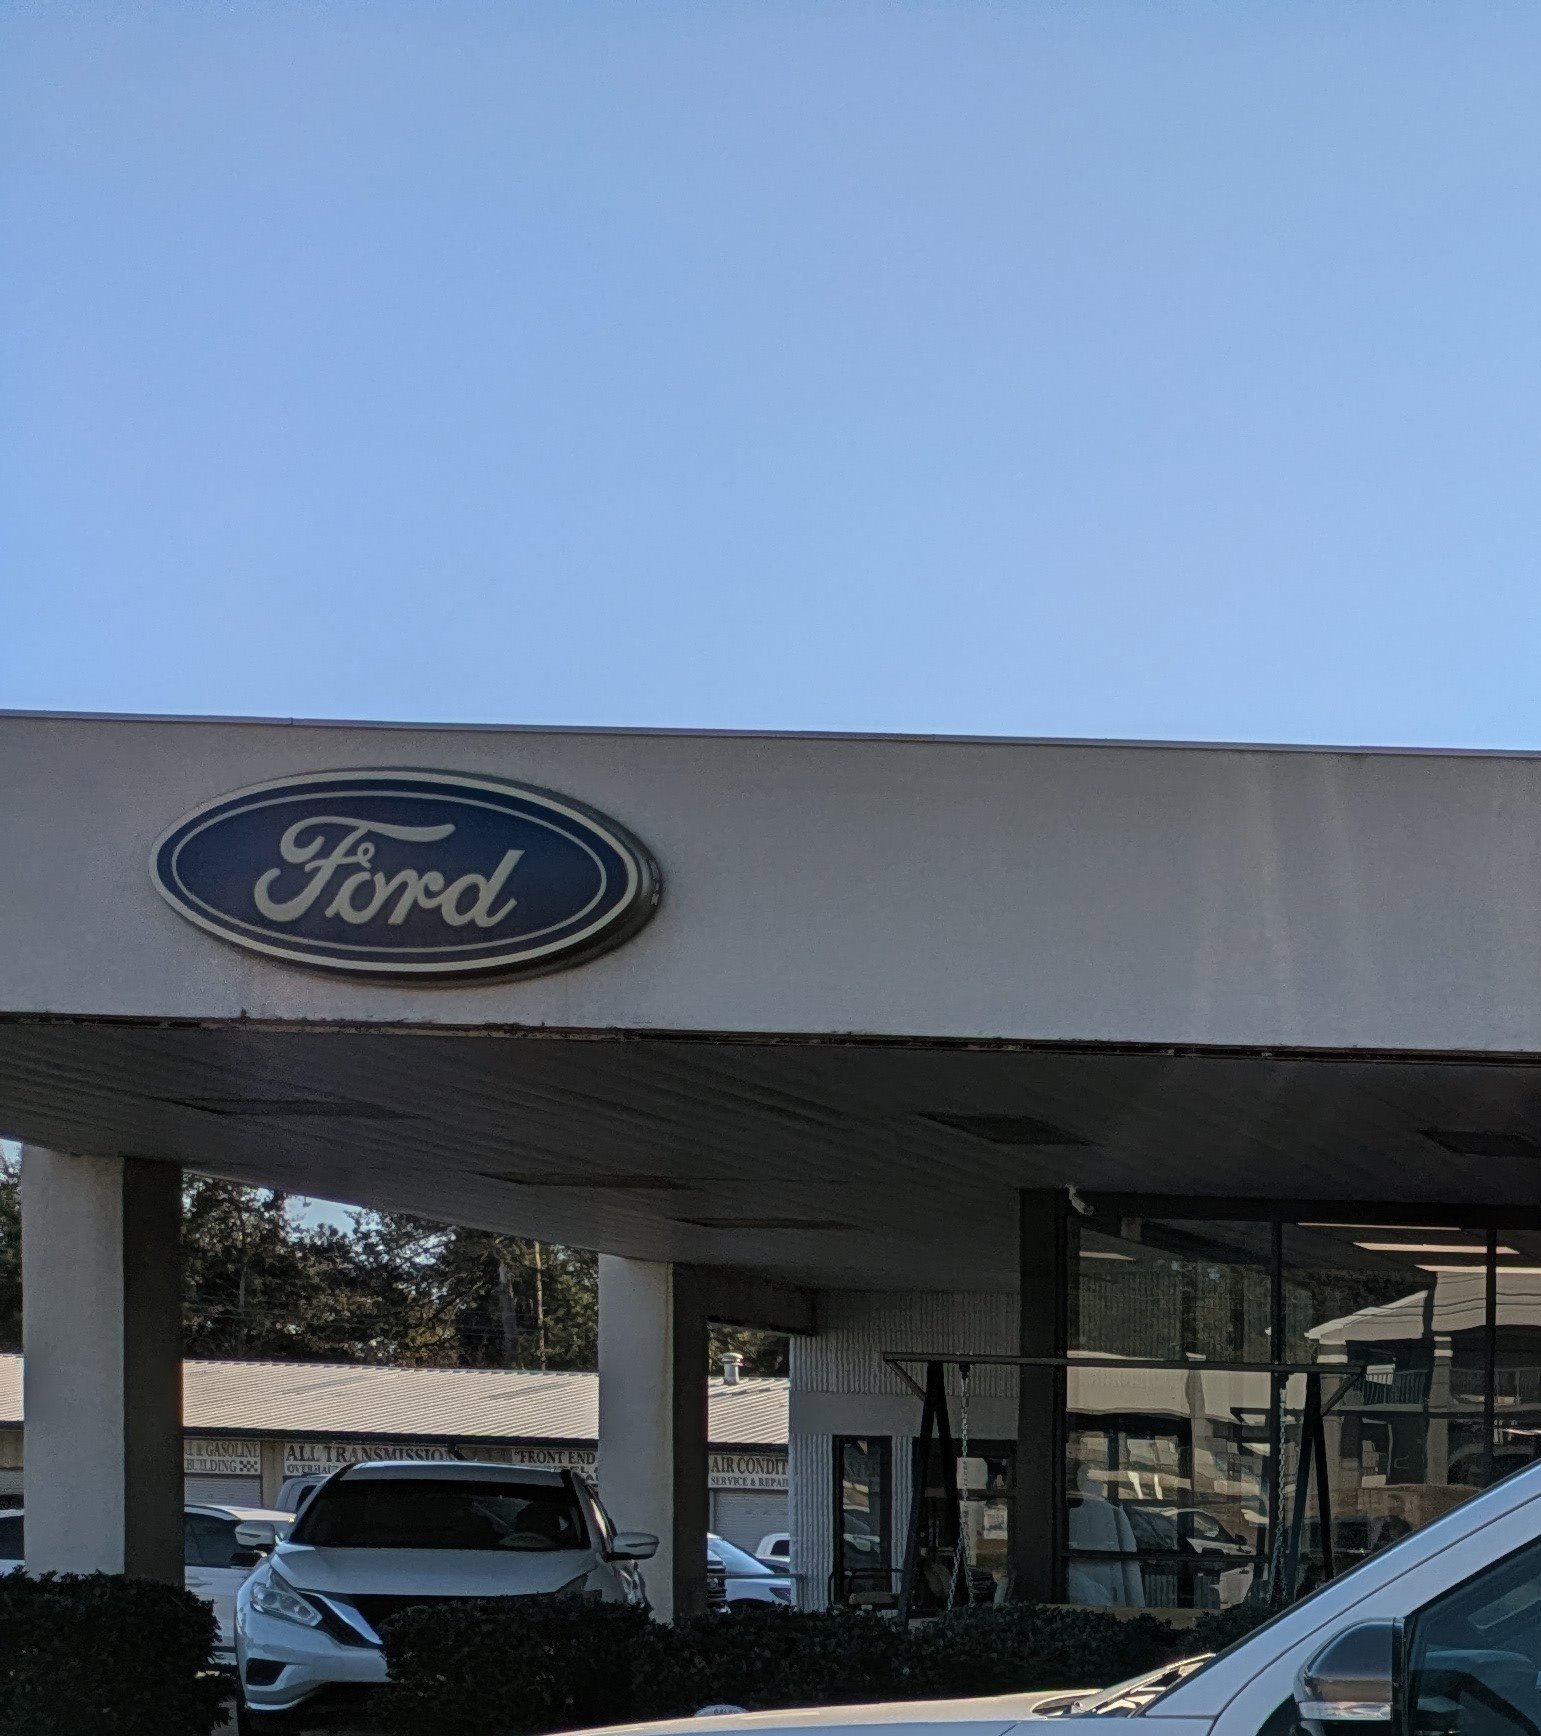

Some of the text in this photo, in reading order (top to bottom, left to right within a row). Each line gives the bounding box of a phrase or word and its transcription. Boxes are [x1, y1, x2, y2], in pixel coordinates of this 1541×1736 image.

[253, 815, 527, 928] Ford
[285, 1445, 319, 1462] ALL
[568, 1451, 596, 1466] END
[711, 1456, 735, 1474] AIR
